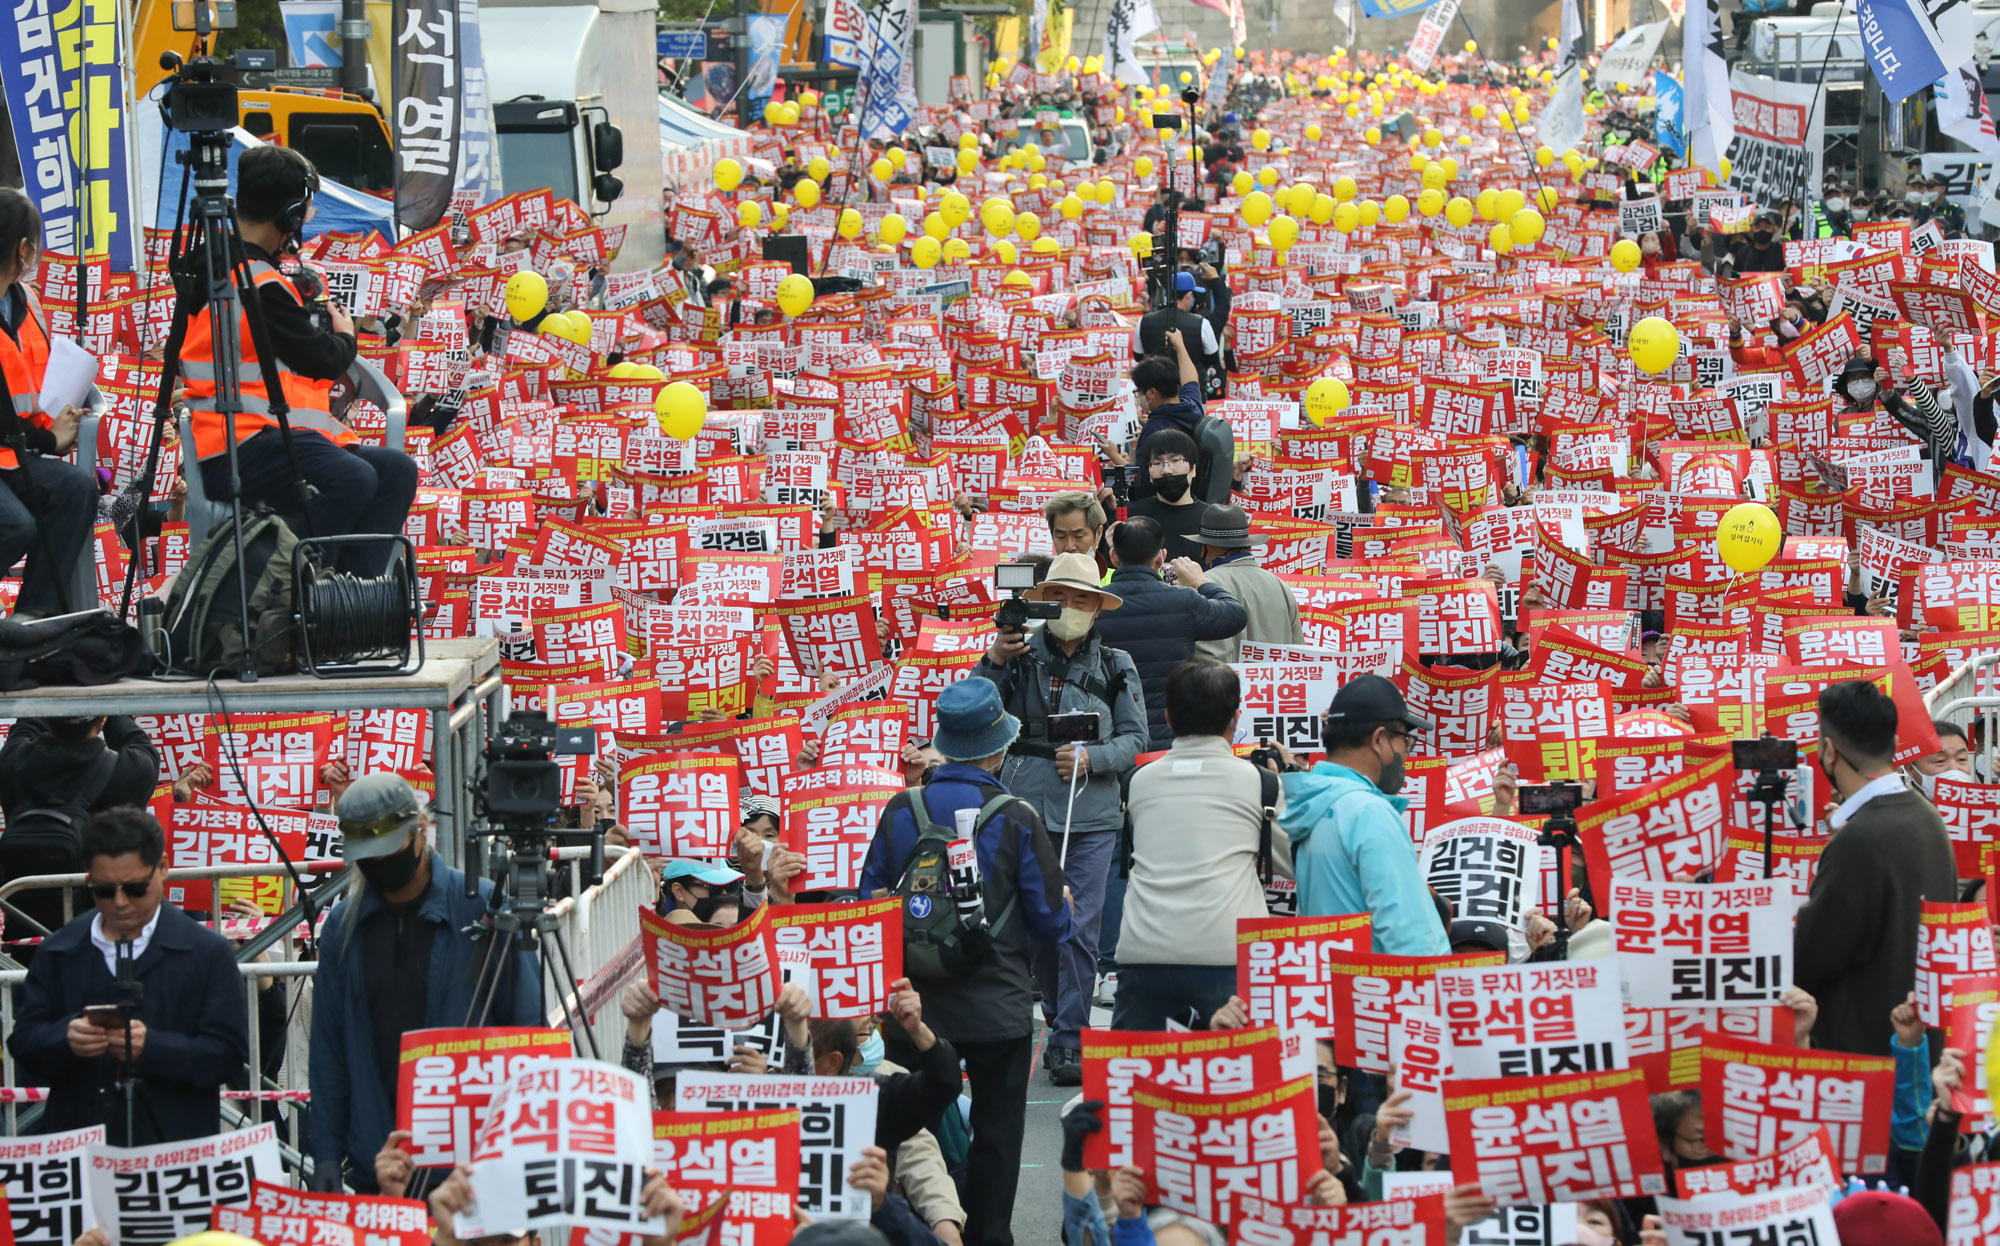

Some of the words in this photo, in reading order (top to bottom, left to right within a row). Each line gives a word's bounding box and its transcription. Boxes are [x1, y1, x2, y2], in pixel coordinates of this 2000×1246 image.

[398, 8, 454, 176] 석열
[475, 202, 516, 229] 윤석열
[1622, 204, 1656, 219] 김건희
[1838, 262, 1895, 286] 윤석열
[1288, 306, 1326, 319] 김건희
[1903, 291, 1966, 317] 윤석열
[1796, 324, 1850, 361] 윤석열
[409, 350, 448, 370] 윤석열
[1486, 359, 1532, 378] 윤석열
[406, 369, 448, 394] 퇴진!
[1063, 376, 1108, 394] 윤석열
[1092, 371, 1117, 380] 거짓말
[1002, 379, 1038, 400] 윤석열
[1434, 389, 1484, 415] 윤석열
[801, 411, 826, 422] 거짓말
[1543, 396, 1600, 424] 윤석열
[1674, 408, 1735, 434] 윤석열
[1777, 409, 1827, 432] 윤석열
[594, 426, 618, 437] 거짓말
[763, 421, 817, 440] 윤석열
[555, 434, 622, 460] 윤석열
[626, 449, 681, 469] 윤석열
[794, 453, 822, 466] 거짓말
[1273, 474, 1293, 485] 무지
[1295, 472, 1323, 484] 거짓말
[1426, 463, 1488, 492] 윤석열
[1870, 464, 1889, 475] 무지
[1892, 462, 1923, 474] 거짓말
[468, 500, 525, 523] 윤석열
[1230, 496, 1260, 510] 주가조작
[1558, 494, 1578, 505] 무지
[1581, 493, 1611, 505] 거짓말
[997, 514, 1018, 525] 무지
[1488, 513, 1508, 526] 무능
[1540, 509, 1572, 520] 거짓말
[549, 531, 612, 567] 윤석열
[701, 530, 768, 551] 김건희
[861, 532, 882, 543] 무지
[886, 531, 917, 543] 거짓말
[1898, 543, 1932, 564] 거짓말
[542, 569, 566, 578] 무지
[569, 568, 604, 579] 거짓말
[782, 565, 840, 594] 윤석열
[1925, 564, 1947, 576] 무능
[1951, 562, 1980, 575] 무지
[478, 581, 504, 593] 무능
[507, 582, 530, 594] 무지
[533, 582, 569, 596] 거짓말
[729, 579, 762, 592] 거짓말
[650, 609, 674, 622] 무능
[677, 610, 702, 623] 무지
[705, 610, 742, 623] 거짓말
[1417, 592, 1488, 620] 윤석열
[544, 617, 614, 648] 윤석열
[789, 612, 861, 642] 윤석열
[1419, 618, 1494, 654] 퇴진!
[656, 648, 679, 661] 무능
[683, 644, 706, 658] 무지
[708, 640, 738, 656] 거짓말
[1798, 630, 1886, 659] 윤석열
[656, 652, 741, 692] 윤석열
[1245, 667, 1274, 681] 무지
[1279, 665, 1323, 681] 거짓말
[1352, 651, 1388, 669] 거짓말
[1546, 649, 1628, 688] 윤석열
[1711, 655, 1738, 668] 무지
[1741, 653, 1779, 667] 거짓말
[1503, 687, 1525, 702] 무능
[1529, 686, 1557, 701] 무지
[1562, 682, 1598, 699] 거짓말
[1766, 674, 1797, 685] 민생파탄
[1407, 675, 1489, 717] 윤석열
[267, 717, 299, 730] 평화파괴
[742, 722, 772, 736] 평화파괴
[1504, 697, 1608, 742] 윤석열
[823, 717, 903, 750] 윤석열
[219, 732, 314, 764] 윤석열
[219, 763, 313, 804] 퇴진!
[628, 773, 728, 810] 윤석열
[784, 770, 842, 793] 주가조작
[173, 808, 242, 827] 주가조작
[1458, 824, 1501, 836] 허위경력
[1601, 782, 1724, 859] 윤석열
[628, 809, 728, 857] 퇴진!
[1430, 837, 1525, 879] 김건희
[829, 908, 865, 923] 평화파괴
[868, 899, 902, 916] 친일매국
[1615, 888, 1654, 909] 무능
[1662, 888, 1703, 911] 무지
[1711, 885, 1774, 909] 거짓말
[776, 922, 882, 963] 윤석열
[1615, 911, 1750, 955] 윤석열
[656, 935, 770, 983] 윤석열
[1441, 975, 1474, 997] 무능
[1481, 970, 1521, 993] 무지
[1530, 964, 1598, 993] 거짓말
[1671, 954, 1781, 1001] 퇴진!
[658, 971, 776, 1028] 퇴진!
[1404, 1016, 1441, 1046] 무능
[1446, 994, 1577, 1047] 윤석열
[571, 1069, 635, 1102] 거짓말
[682, 1086, 742, 1100] 주가조작
[747, 1084, 805, 1098] 허위경력
[811, 1081, 871, 1096] 상습사기
[1107, 1054, 1254, 1105] 윤석열
[1723, 1061, 1865, 1122] 윤석열
[1153, 1107, 1298, 1165] 윤석열
[1470, 1096, 1626, 1158] 윤석열
[47, 1129, 103, 1153] 상습사기
[154, 1143, 215, 1167] 허위경력
[220, 1127, 274, 1156] 상습사기
[1477, 1143, 1636, 1206] 퇴진!
[1734, 1158, 1774, 1185] 무지
[255, 1186, 350, 1222] 주가조작
[1291, 1208, 1339, 1231] 무지
[1346, 1199, 1416, 1229] 거짓말
[355, 1202, 428, 1234] 허위경력
